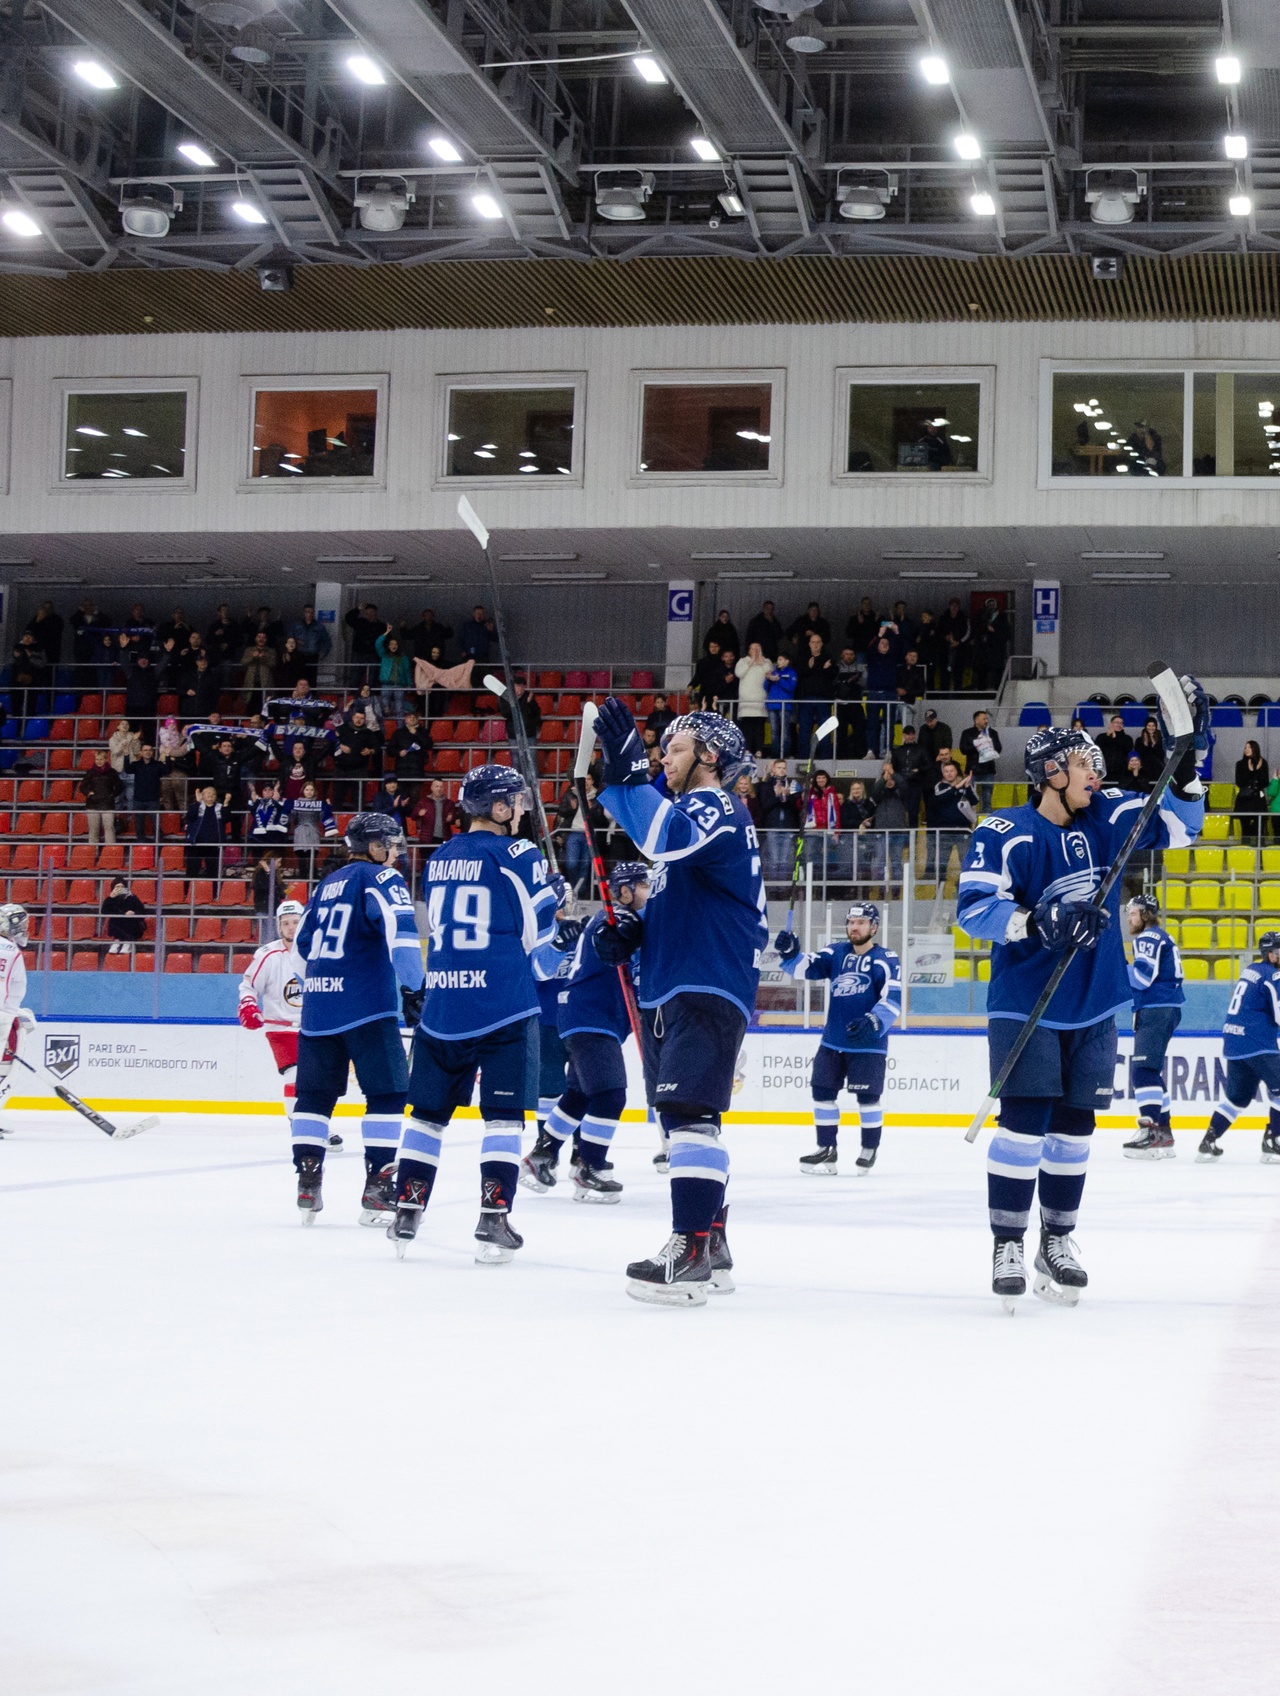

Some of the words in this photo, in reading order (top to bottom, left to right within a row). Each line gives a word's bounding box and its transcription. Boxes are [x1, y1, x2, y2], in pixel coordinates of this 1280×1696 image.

[671, 592, 690, 615] G
[1036, 591, 1056, 614] H
[275, 725, 330, 738] БУРАН
[294, 800, 322, 808] БУРАН
[685, 797, 720, 831] 73
[970, 842, 985, 868] 3
[387, 885, 411, 904] 69
[428, 886, 491, 951] 49
[861, 955, 871, 972] C
[908, 972, 948, 984] PARI
[1227, 981, 1248, 1015] 8
[46, 1045, 79, 1066] ВХЛ
[88, 1044, 111, 1053] PARI
[116, 1044, 135, 1053] ВХЛ
[88, 1058, 120, 1067] КУБОК
[124, 1058, 187, 1069] ШЕЛКОВОГО
[190, 1060, 217, 1070] ПУТИ
[656, 1083, 678, 1092] CM
[887, 1078, 960, 1091] ОБЛАСТИ
